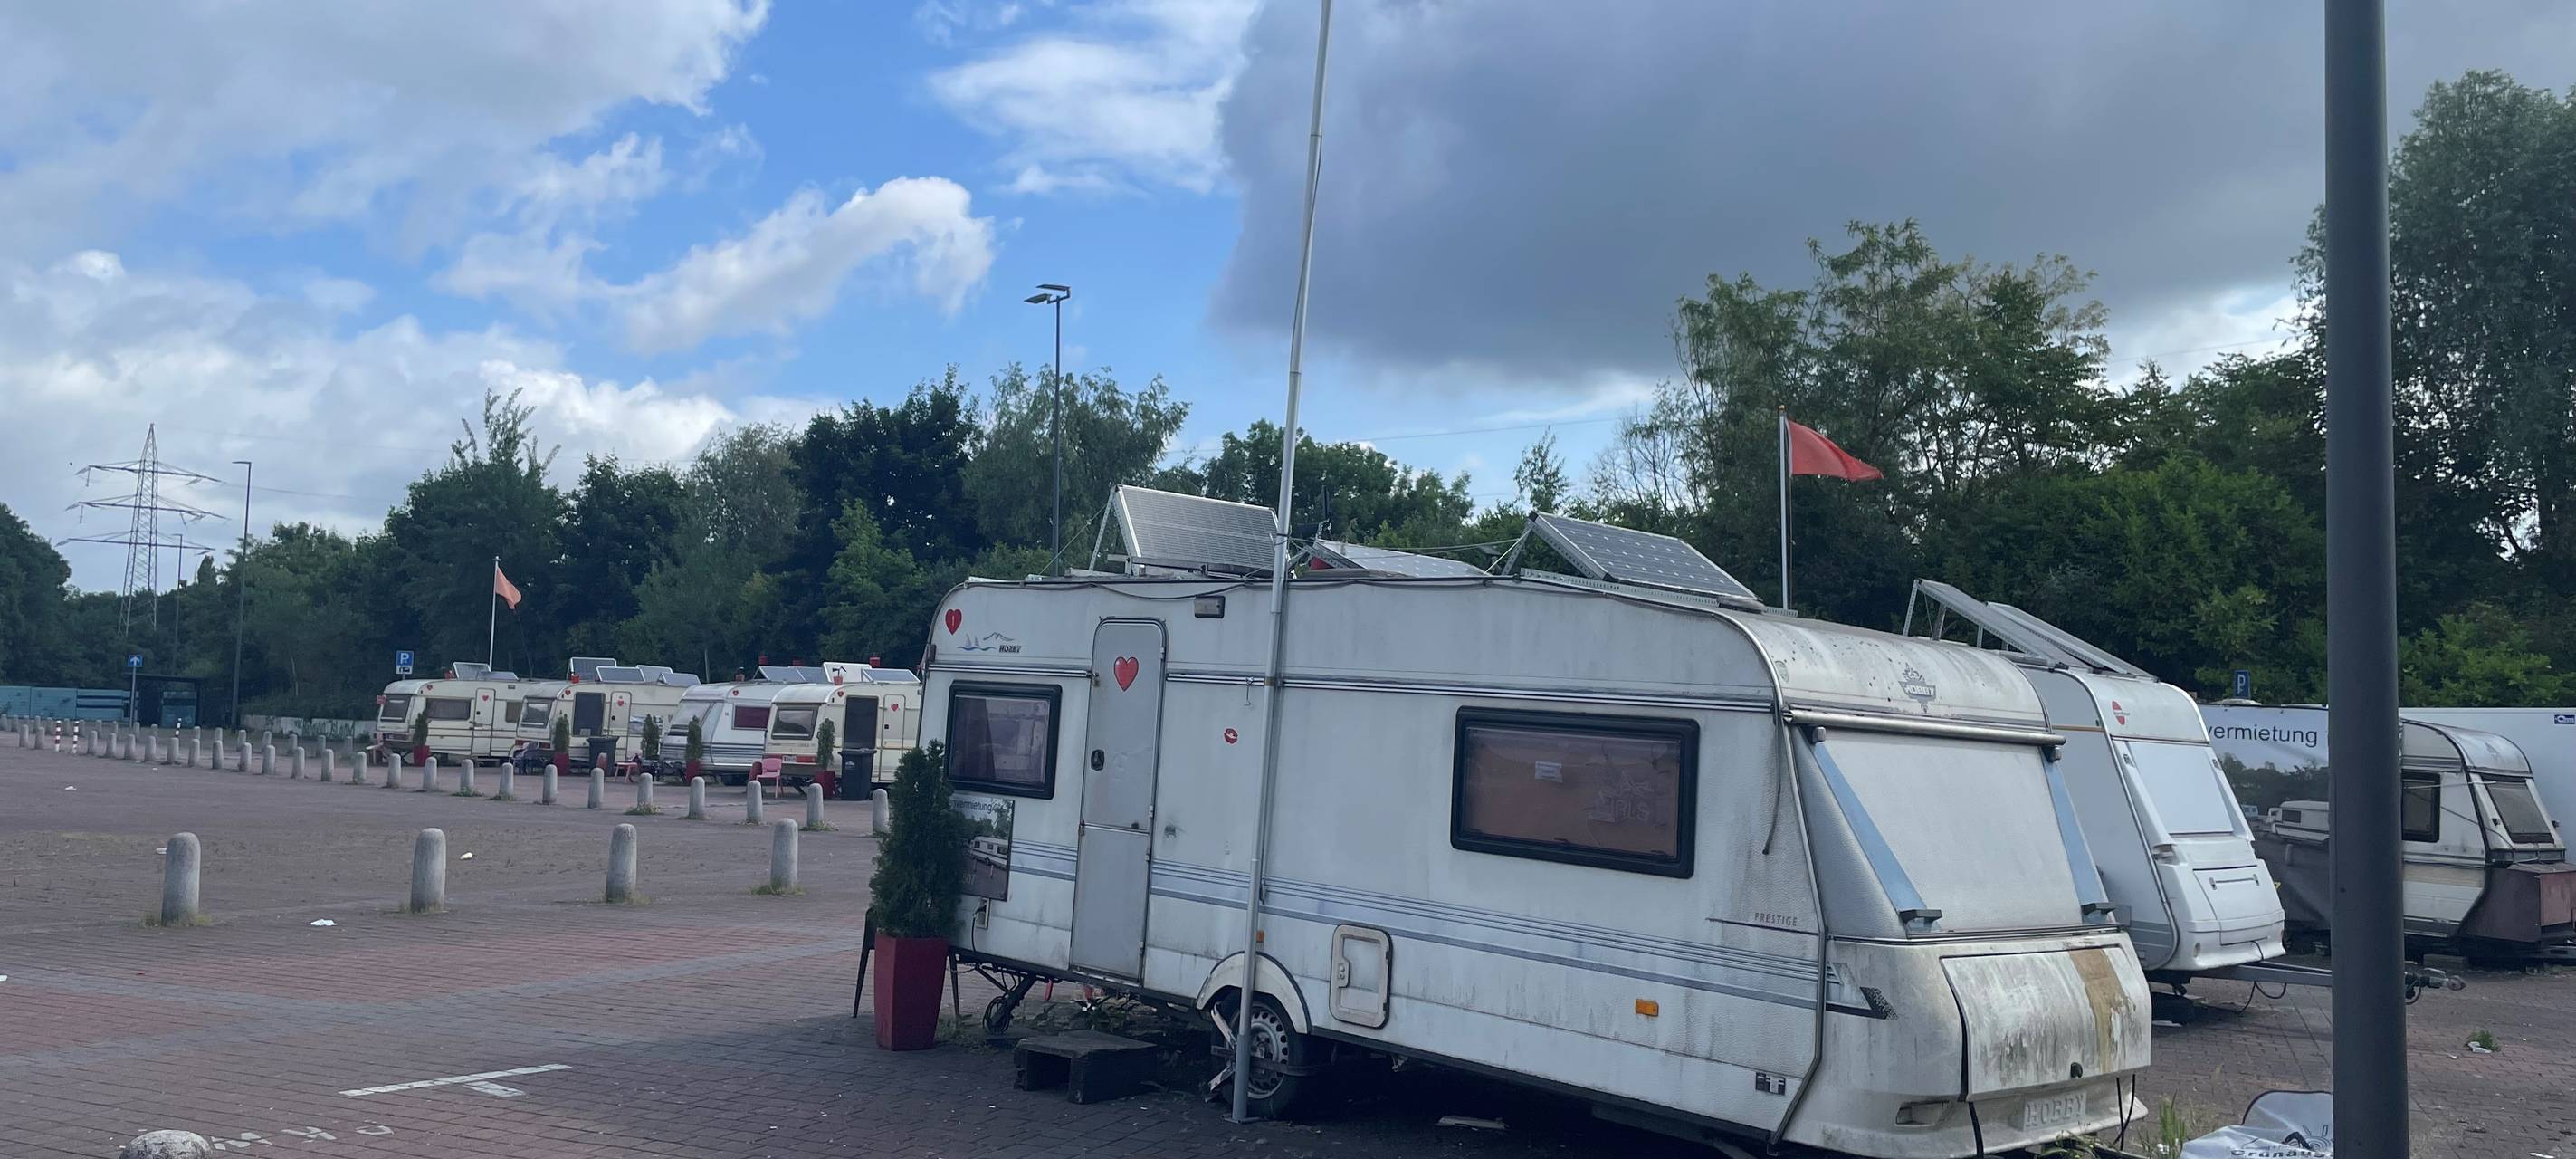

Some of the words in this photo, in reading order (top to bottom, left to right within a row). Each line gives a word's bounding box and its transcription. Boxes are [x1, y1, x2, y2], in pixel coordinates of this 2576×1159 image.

[400, 652, 410, 665] P
[2237, 674, 2246, 694] P
[1754, 912, 1798, 927] PRESTIGE
[2026, 1093, 2086, 1127] HOBBY
